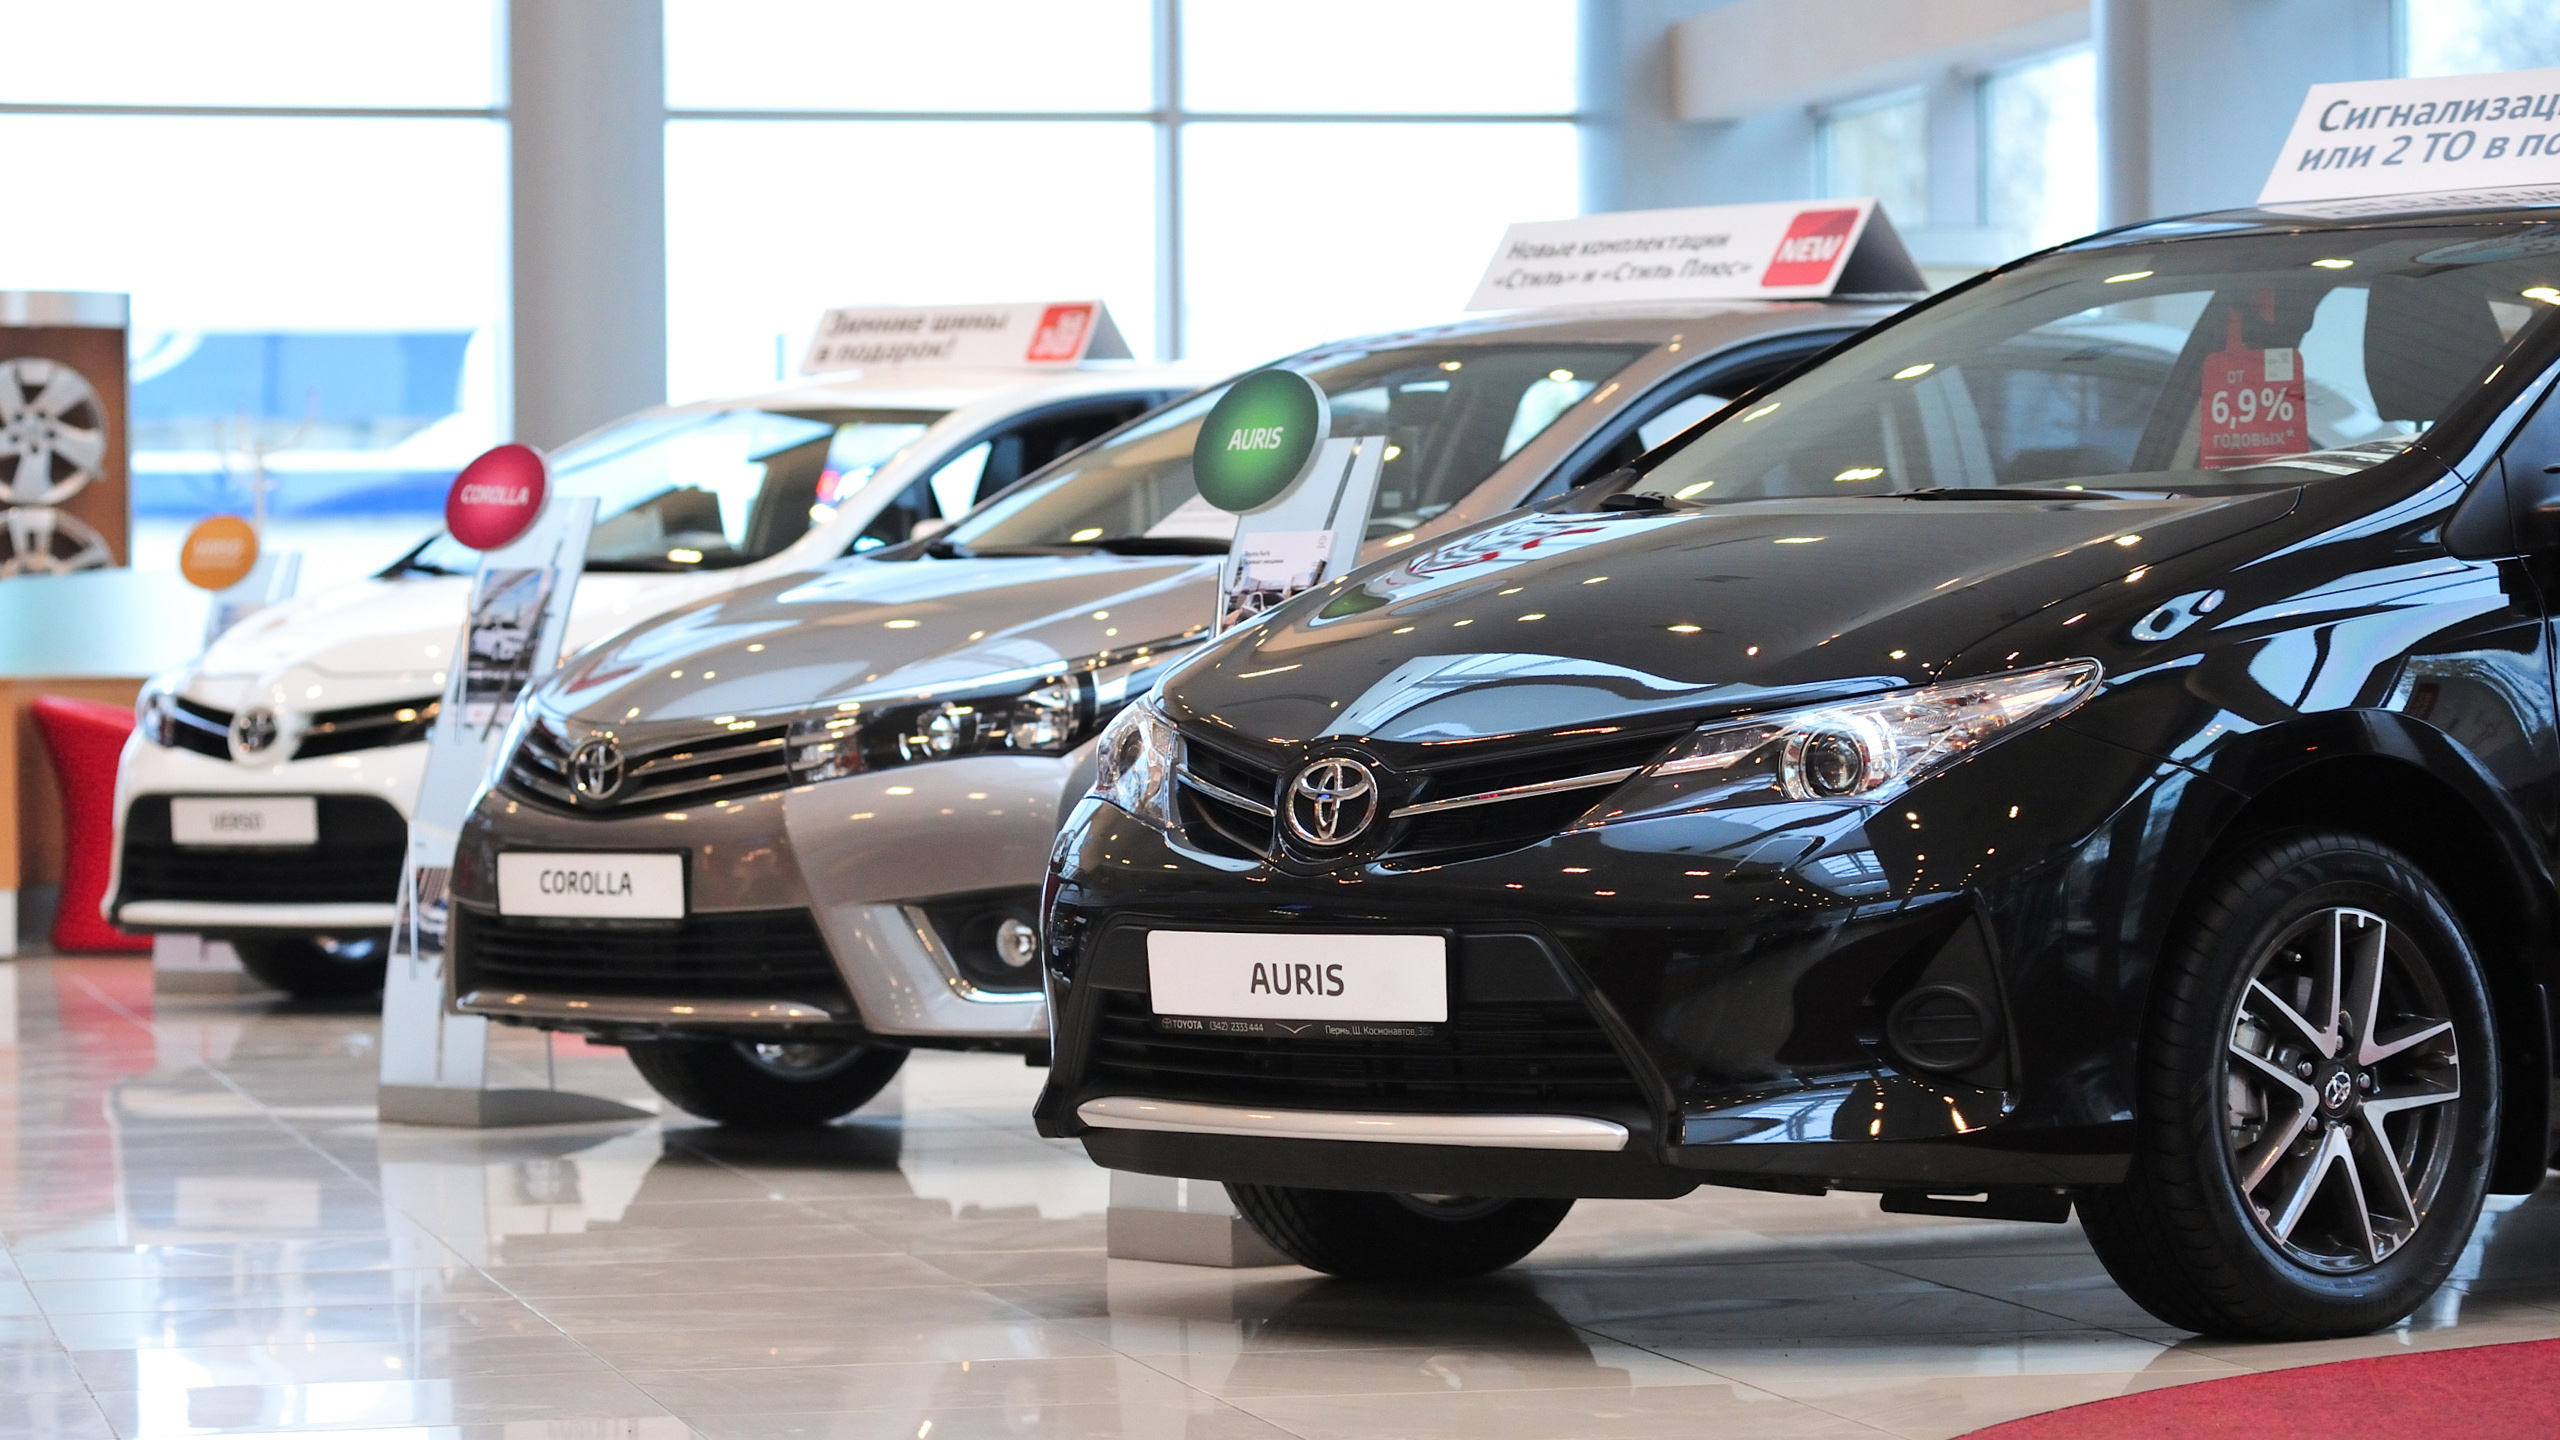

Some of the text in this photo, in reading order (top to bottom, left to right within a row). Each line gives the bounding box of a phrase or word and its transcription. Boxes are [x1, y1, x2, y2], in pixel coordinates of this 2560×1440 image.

[2319, 94, 2560, 132] Сигнализац
[2297, 145, 2376, 171] или
[2381, 135, 2413, 165] 2
[2422, 130, 2476, 162] ТО
[2482, 136, 2510, 159] в
[1506, 233, 1732, 261] Новые комплектации
[1774, 233, 1844, 263] NEW
[1493, 257, 1752, 290] «Стиль» и «Стиль Плюс»
[826, 309, 923, 337] Зимние
[930, 312, 1011, 333] шины
[837, 335, 959, 365] подарок!
[2211, 387, 2294, 430] 6,9%
[1227, 426, 1284, 451] AURIS
[460, 484, 530, 507] COROLLA
[540, 870, 633, 896] COROLLA
[1250, 962, 1345, 996] AURIS
[1172, 1019, 1203, 1030] TOYOTA
[1209, 1020, 1229, 1031] (342)
[1325, 1025, 1352, 1036] Пермь,
[1352, 1025, 1363, 1036] Ш.
[1364, 1025, 1417, 1037] Космонавтов,
